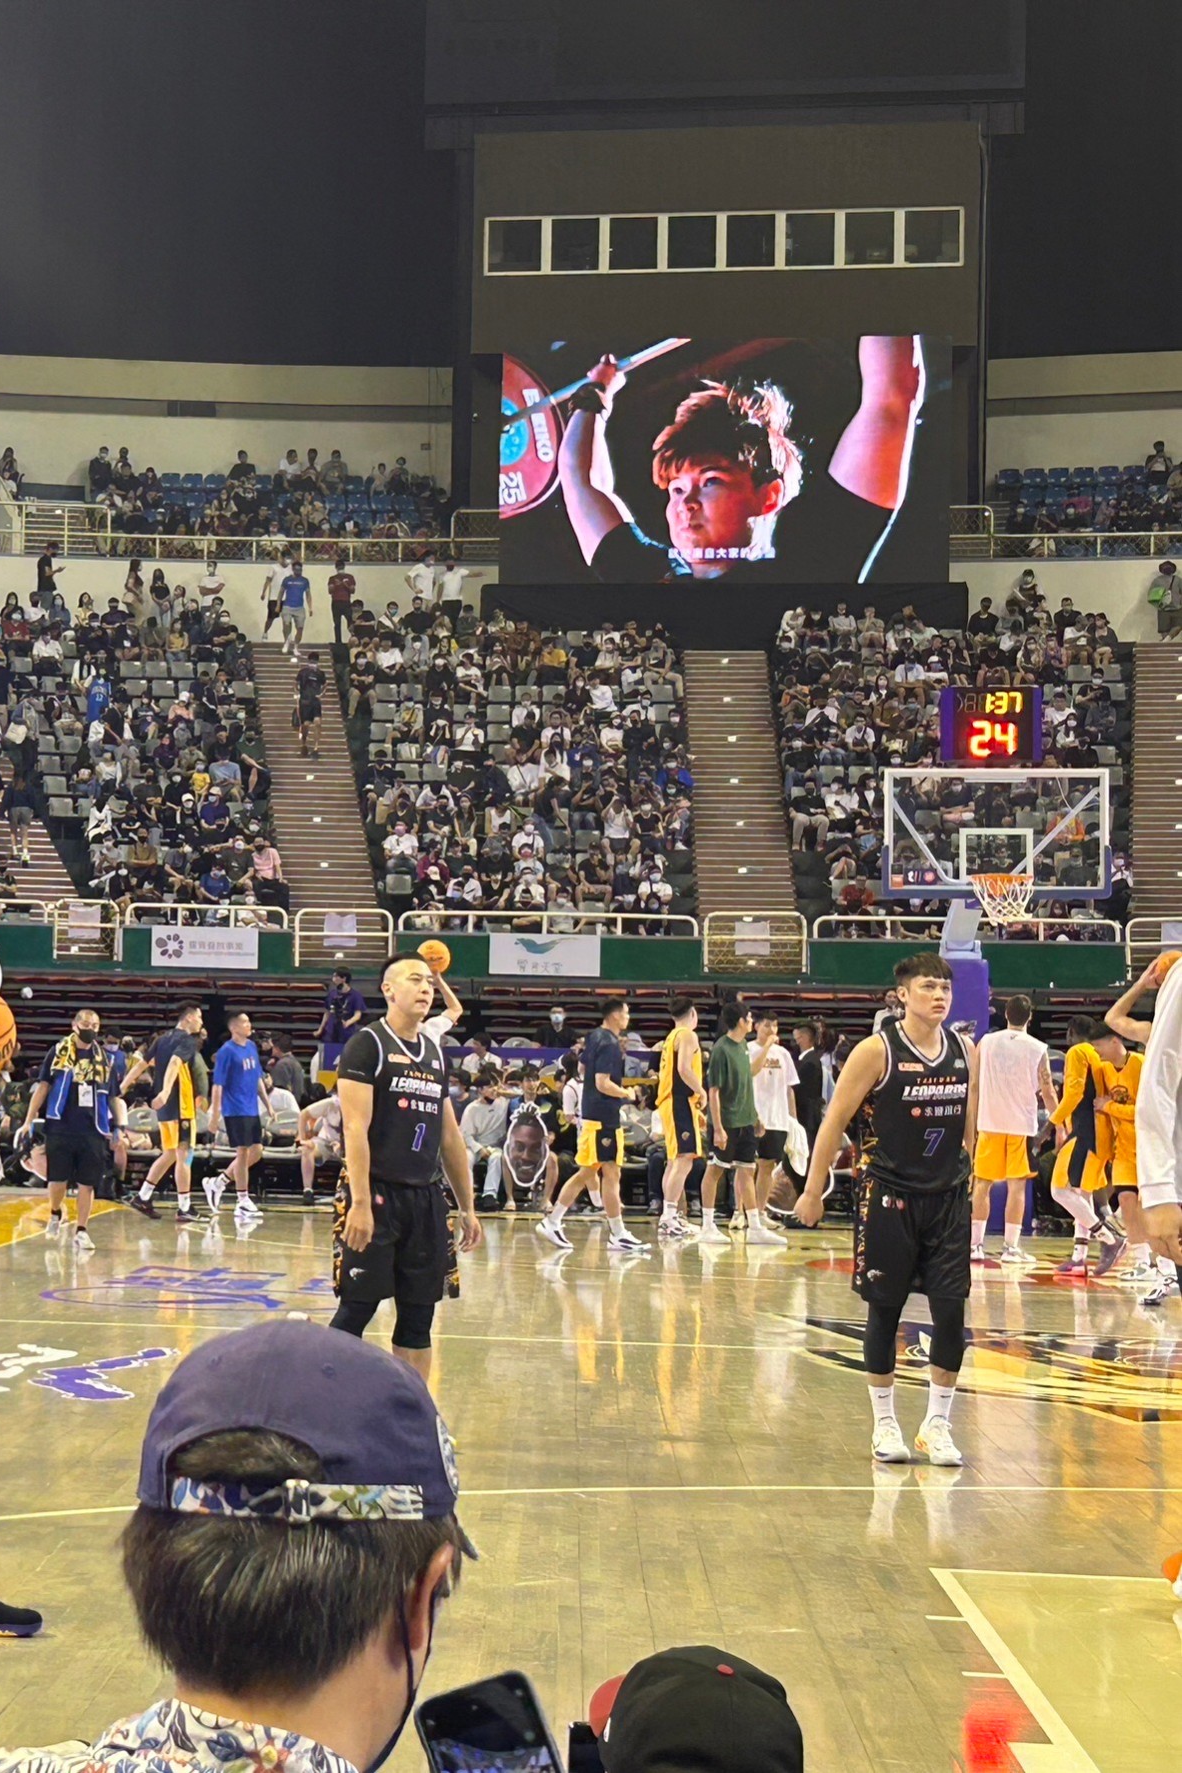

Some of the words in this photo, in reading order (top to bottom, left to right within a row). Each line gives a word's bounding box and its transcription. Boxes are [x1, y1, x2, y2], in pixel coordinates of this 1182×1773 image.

[522, 388, 555, 463] EEIKO
[985, 691, 1023, 714] 1:37
[969, 720, 1016, 758] 24
[901, 1083, 967, 1101] LEOPARDS
[411, 1122, 427, 1152] 1
[922, 1127, 945, 1157] 7
